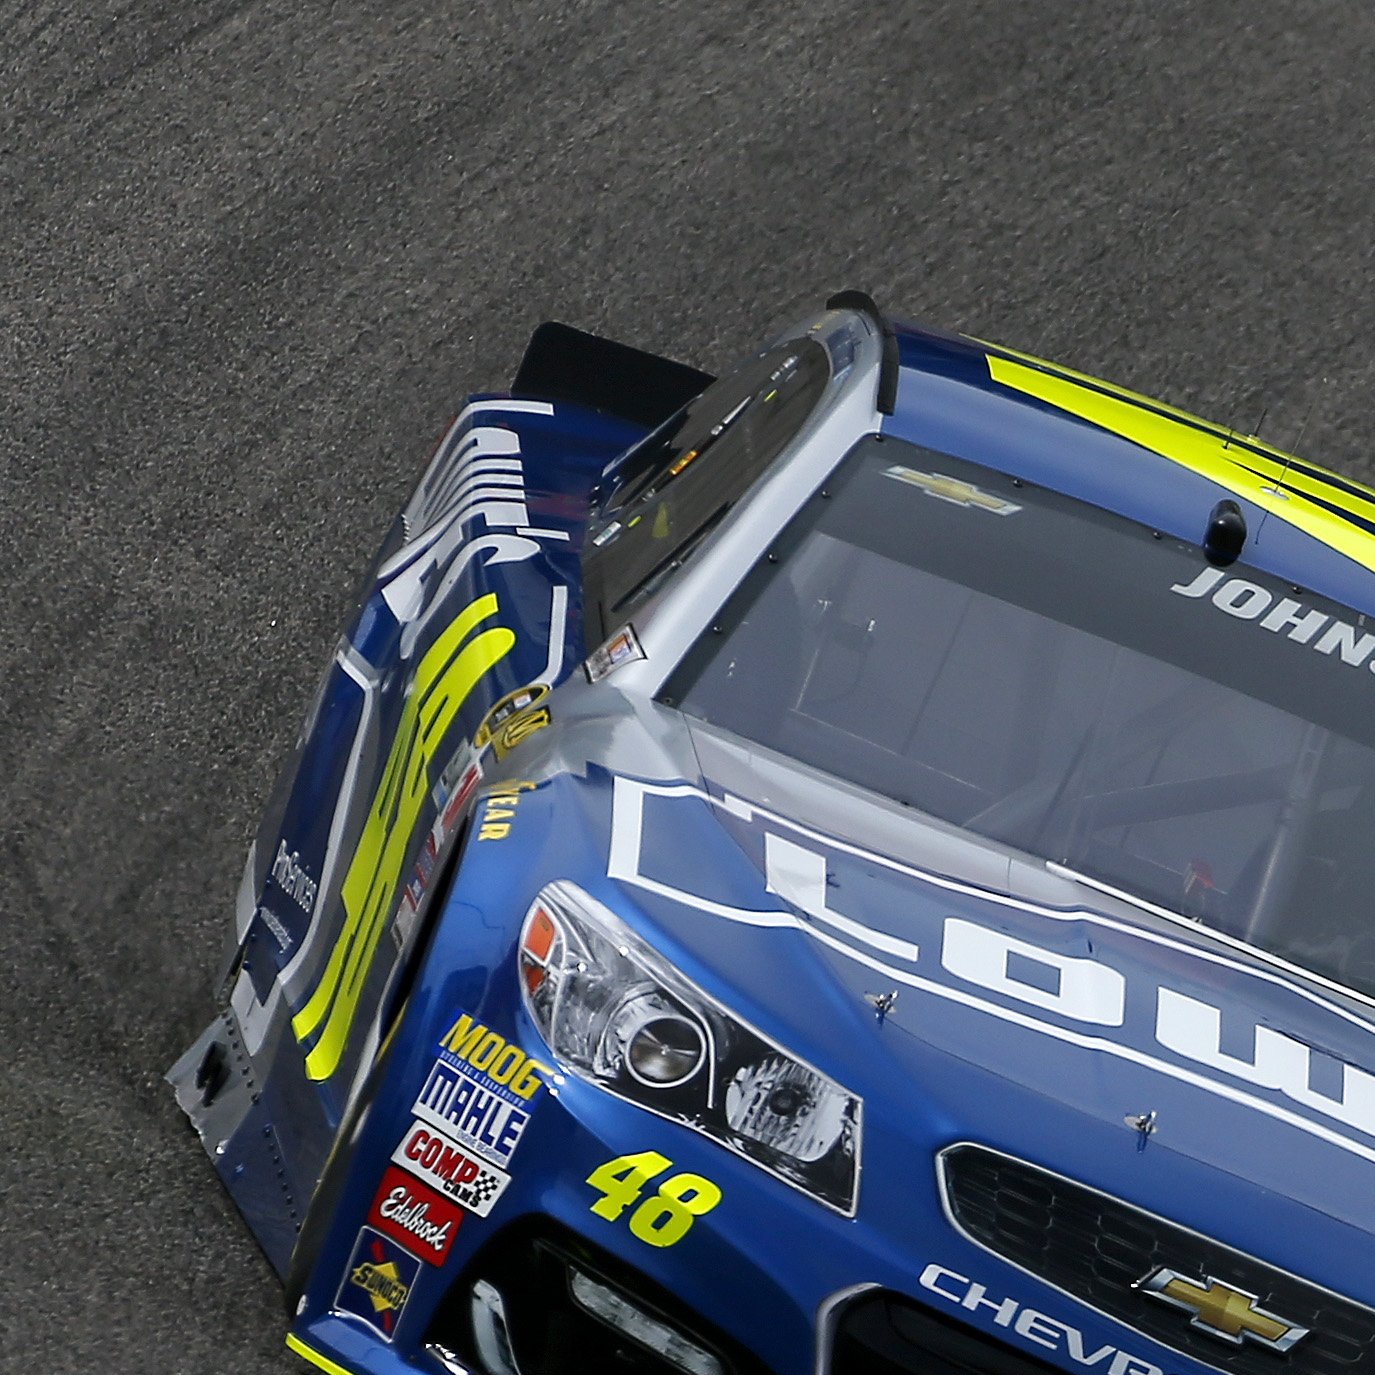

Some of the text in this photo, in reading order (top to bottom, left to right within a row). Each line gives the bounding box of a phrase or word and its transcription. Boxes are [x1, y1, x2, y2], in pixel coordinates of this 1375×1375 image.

[439, 1013, 552, 1101] MOOG
[418, 1065, 526, 1157] MAHLE
[404, 1129, 480, 1186] COMP
[443, 1178, 482, 1208] CAMS
[379, 1185, 452, 1252] Edelbrock
[586, 1150, 722, 1248] 48
